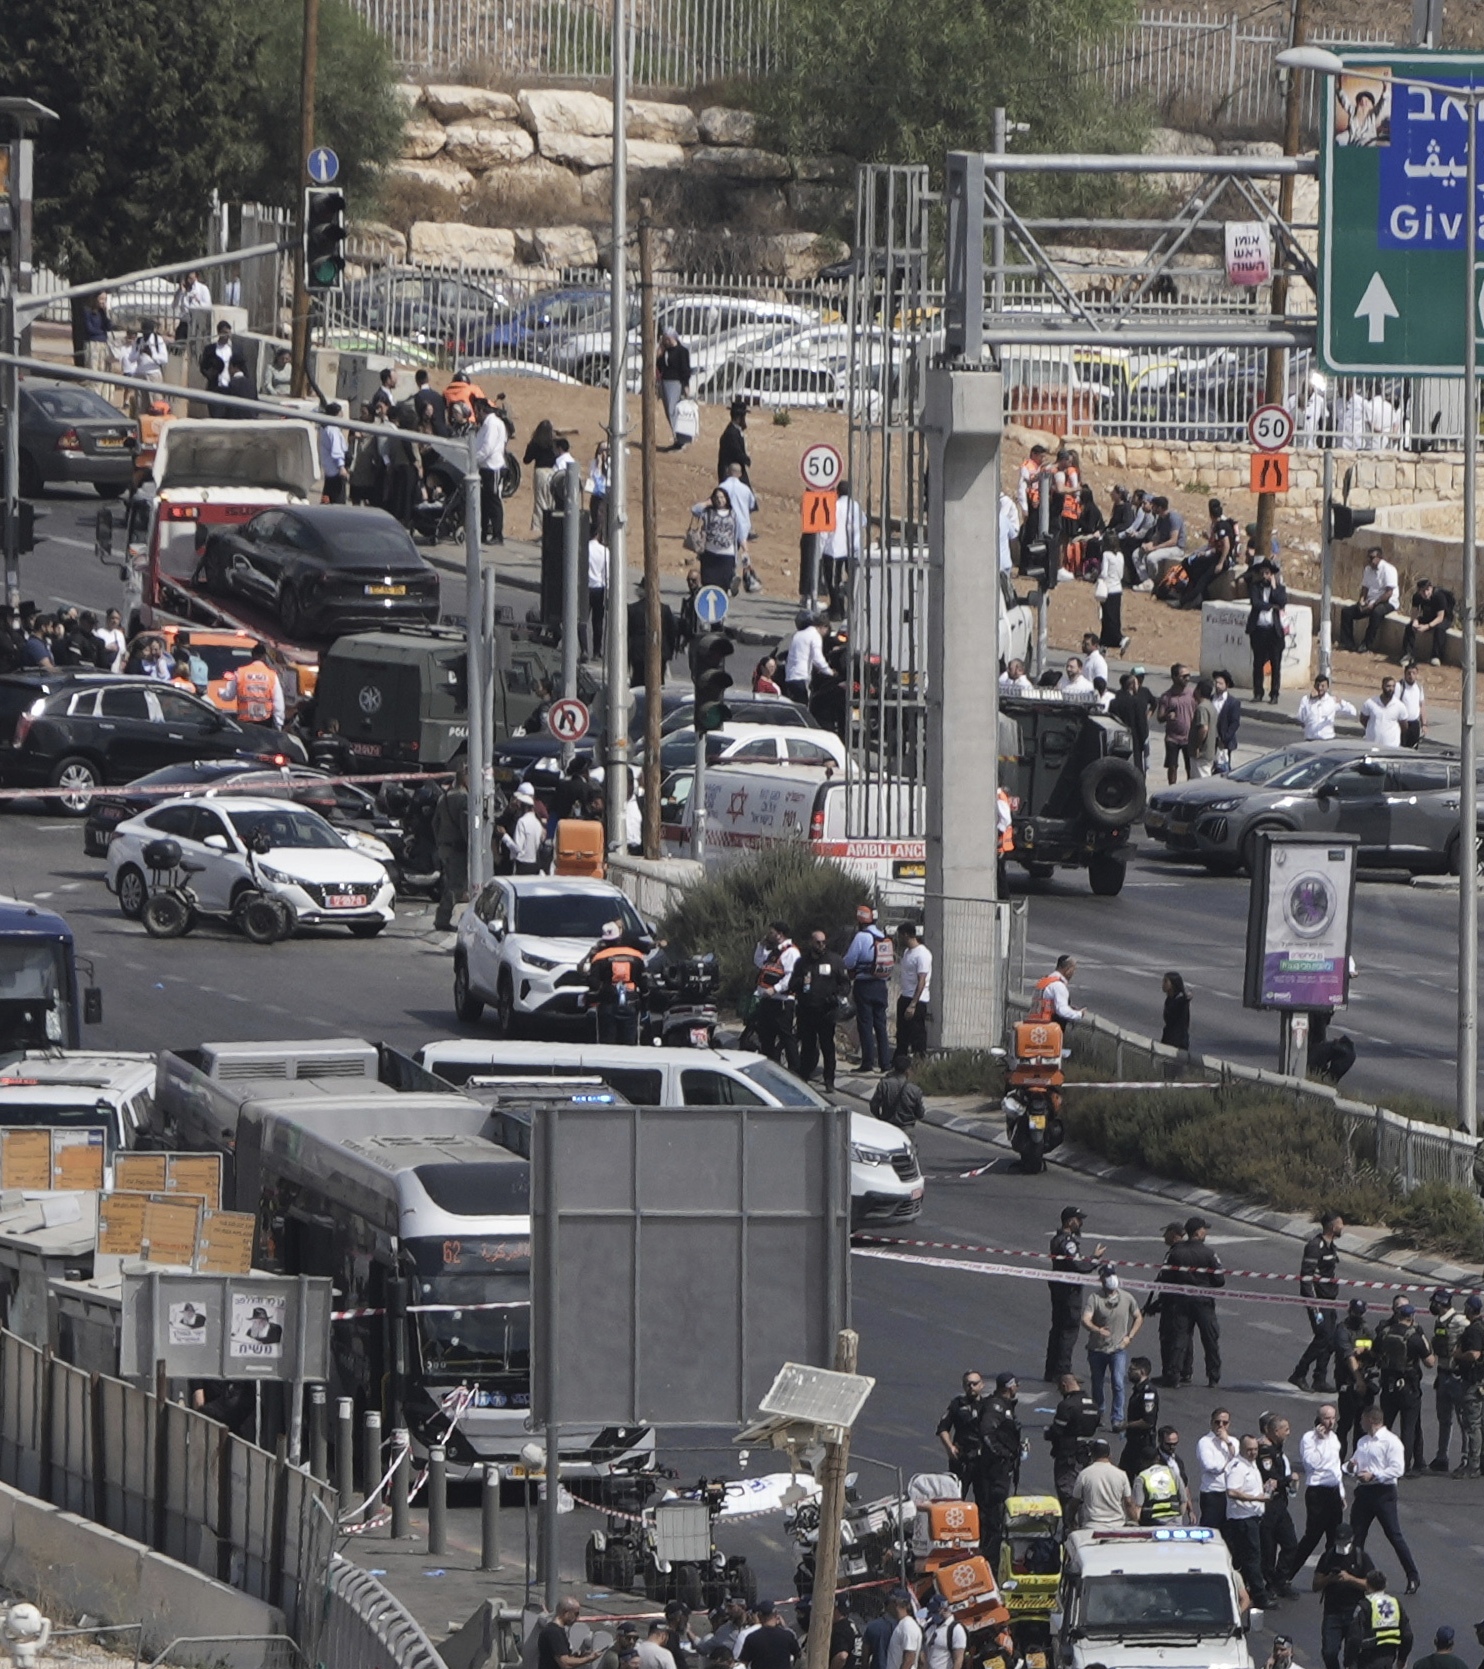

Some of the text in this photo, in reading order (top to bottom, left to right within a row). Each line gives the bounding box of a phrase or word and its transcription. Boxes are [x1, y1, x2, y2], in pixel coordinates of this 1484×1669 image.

[1258, 417, 1285, 438] 50
[809, 456, 835, 477] 50
[443, 1241, 461, 1263] 62
[239, 1343, 274, 1356] משיח
